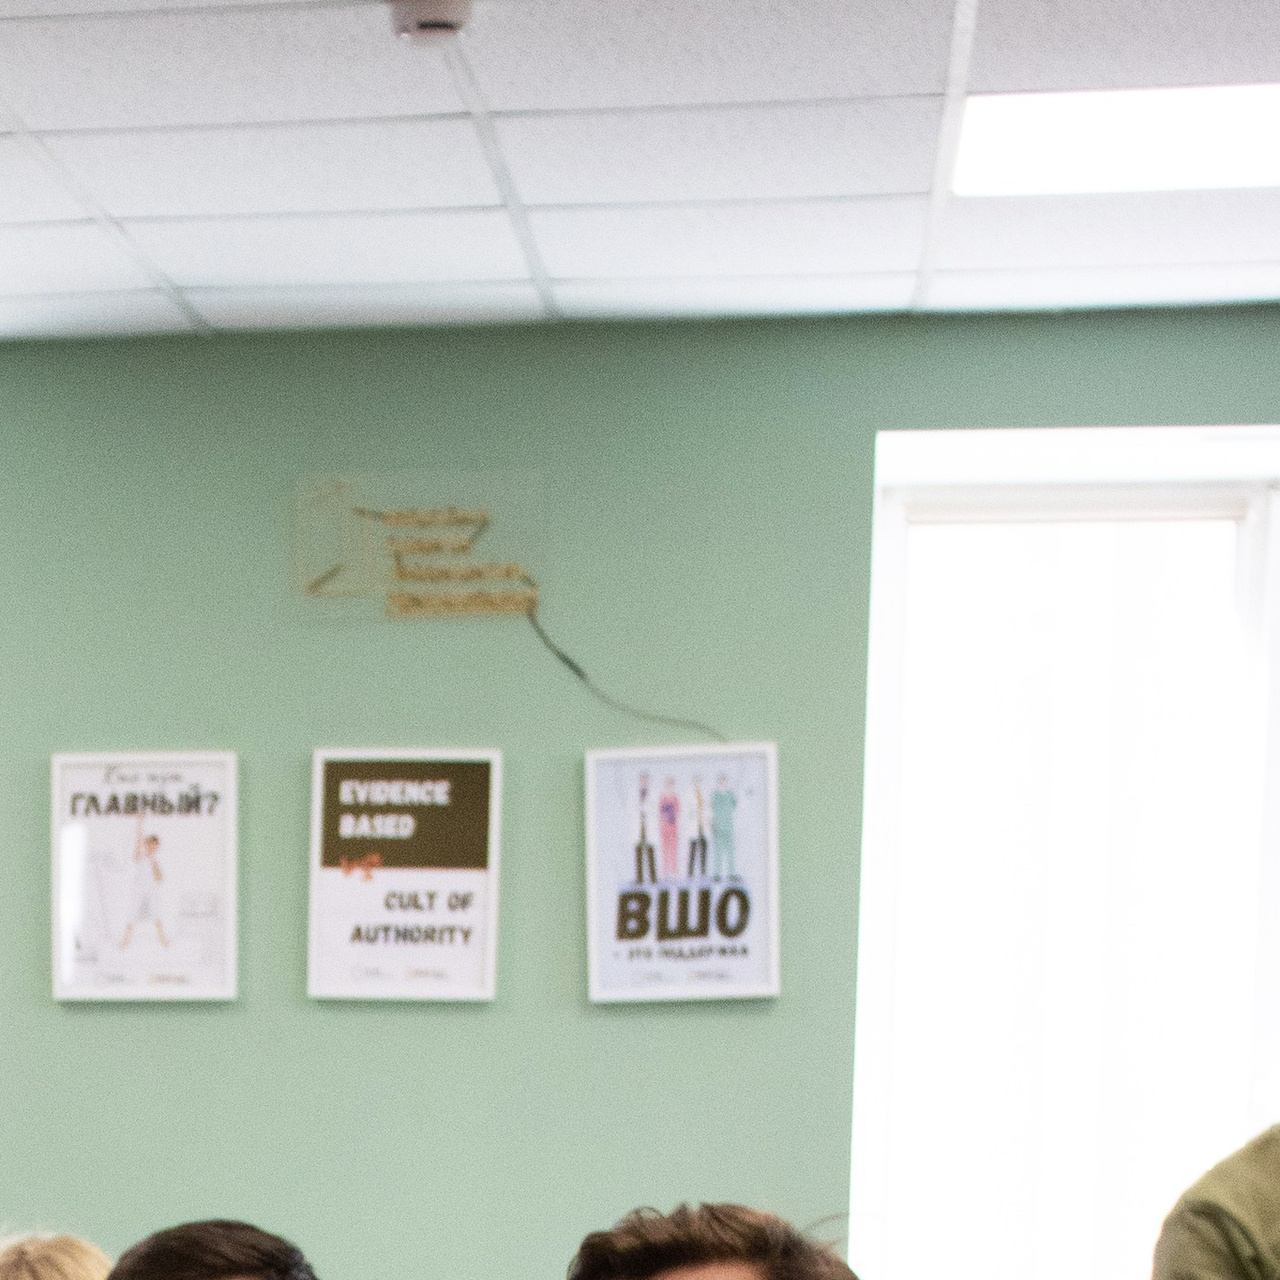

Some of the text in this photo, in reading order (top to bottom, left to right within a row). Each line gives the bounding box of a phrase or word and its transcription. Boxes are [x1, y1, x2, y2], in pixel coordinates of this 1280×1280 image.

[70, 784, 221, 817] ГЛАВНЫЙ?
[339, 780, 451, 805] EVIDENCE
[339, 815, 415, 838] BASED
[384, 891, 474, 911] CULT OF
[617, 888, 750, 941] ВШО
[350, 924, 473, 946] AUTHORITY
